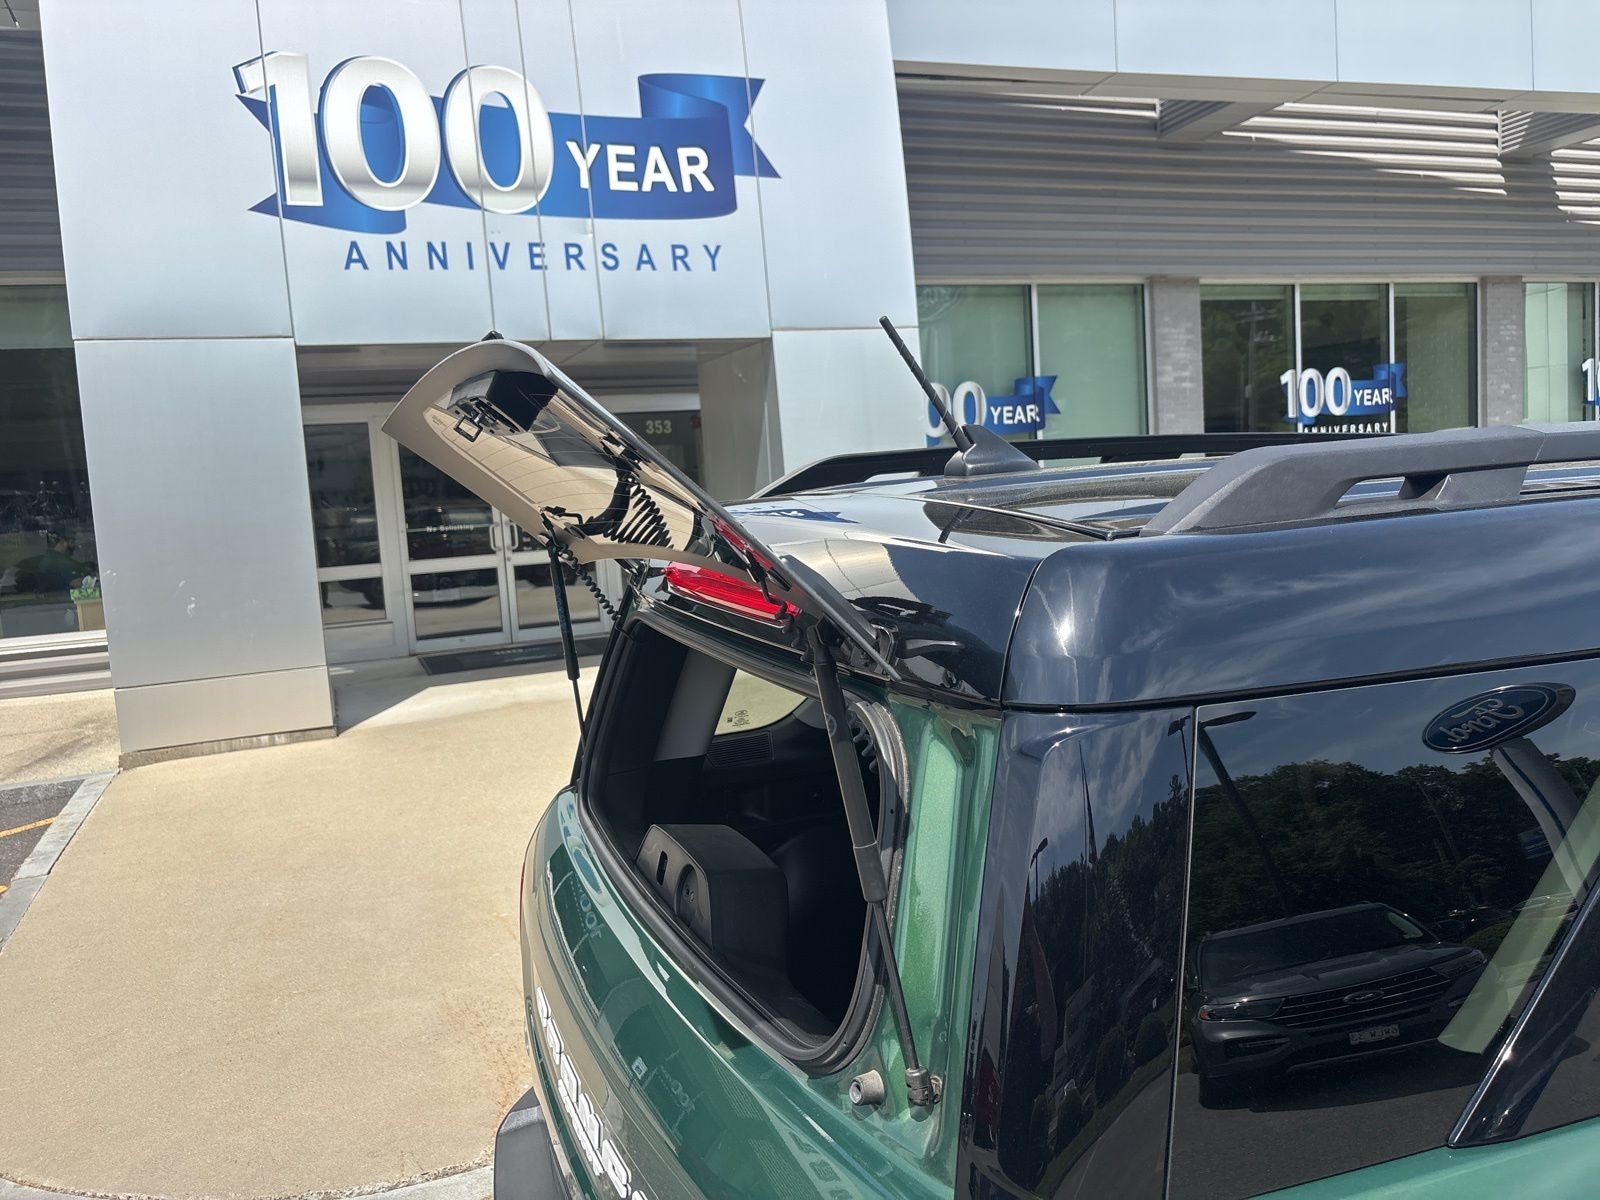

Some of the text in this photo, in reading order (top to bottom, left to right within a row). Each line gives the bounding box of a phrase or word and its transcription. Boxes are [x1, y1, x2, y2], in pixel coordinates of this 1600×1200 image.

[233, 51, 716, 214] 100 YEAR
[343, 241, 723, 272] ANNIVERSARY
[1280, 367, 1394, 418] 100 YEAR
[646, 420, 672, 434] 353
[990, 404, 1041, 425] YEAR
[1303, 422, 1388, 434] ANNIVERSARY
